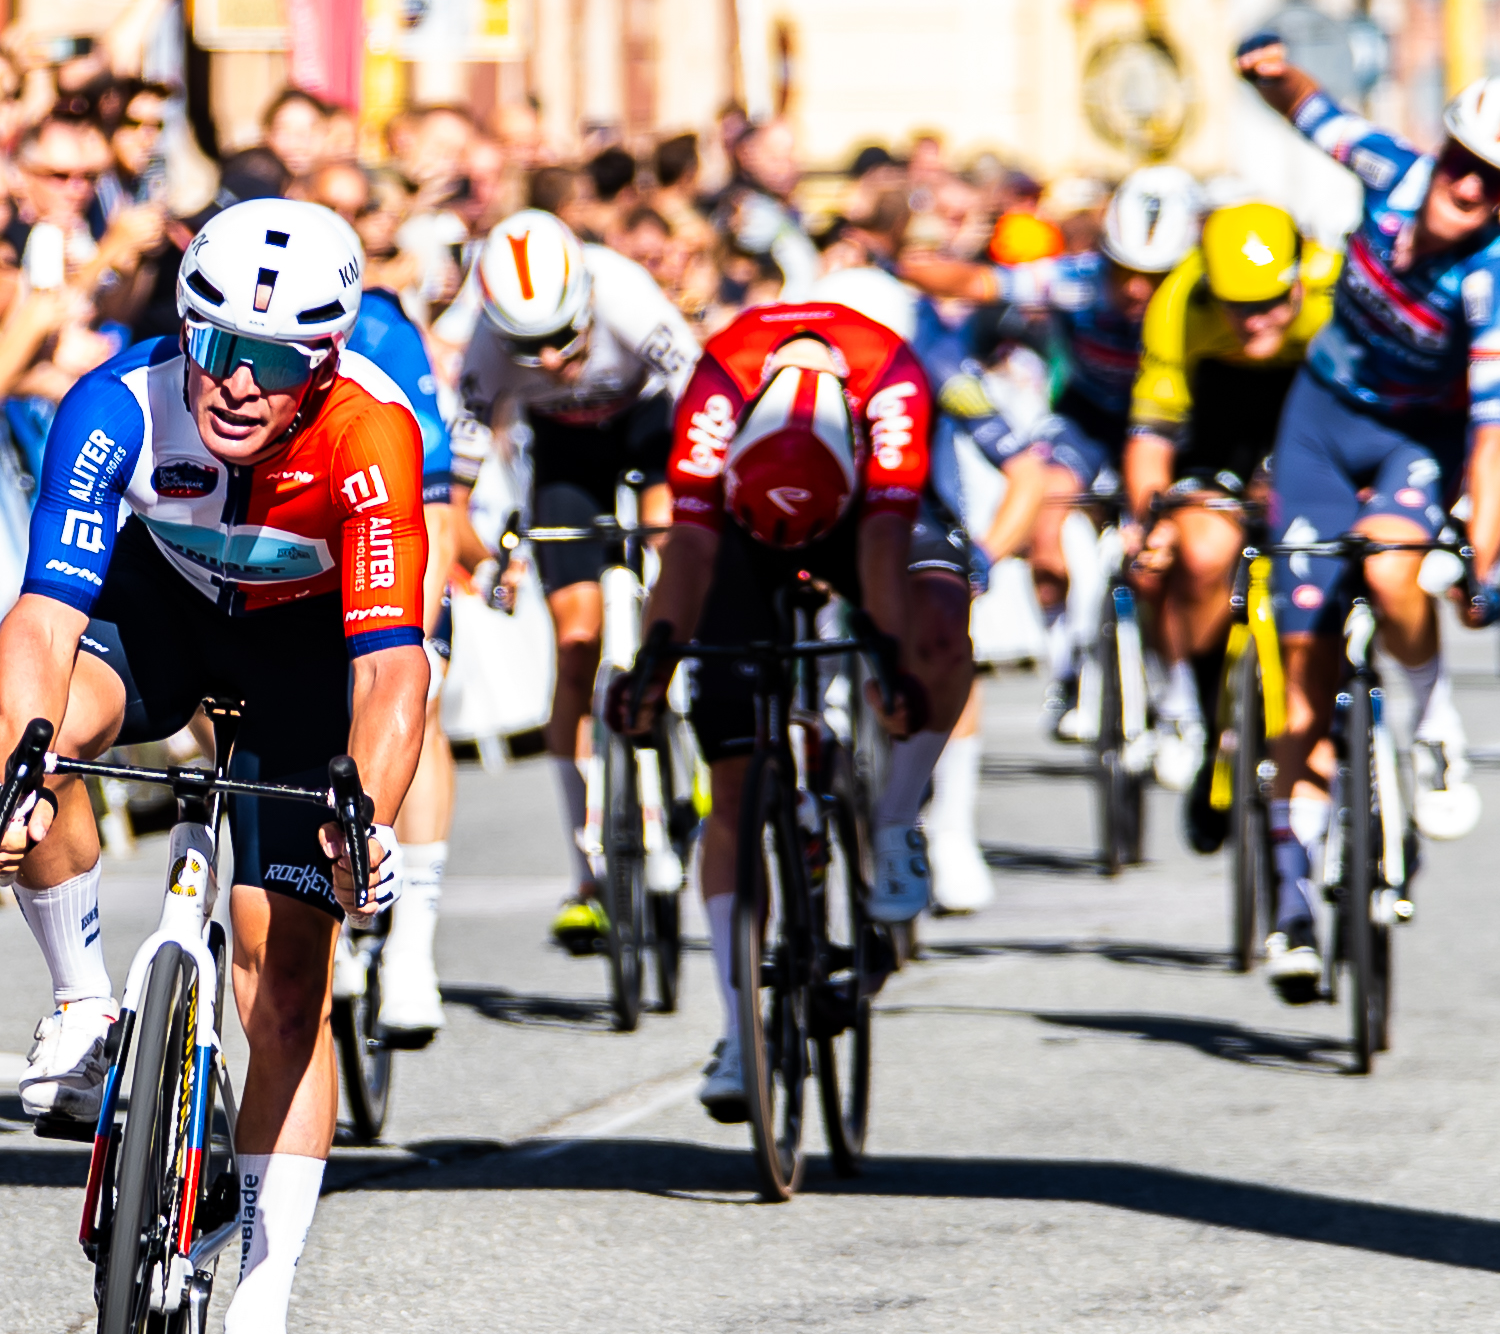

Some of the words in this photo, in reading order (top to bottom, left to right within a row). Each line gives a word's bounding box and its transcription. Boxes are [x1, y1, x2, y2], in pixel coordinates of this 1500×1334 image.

[68, 428, 115, 503] ALITER
[677, 394, 737, 478] lotto
[370, 517, 395, 589] ALITER
[265, 863, 338, 905] ROCKETS
